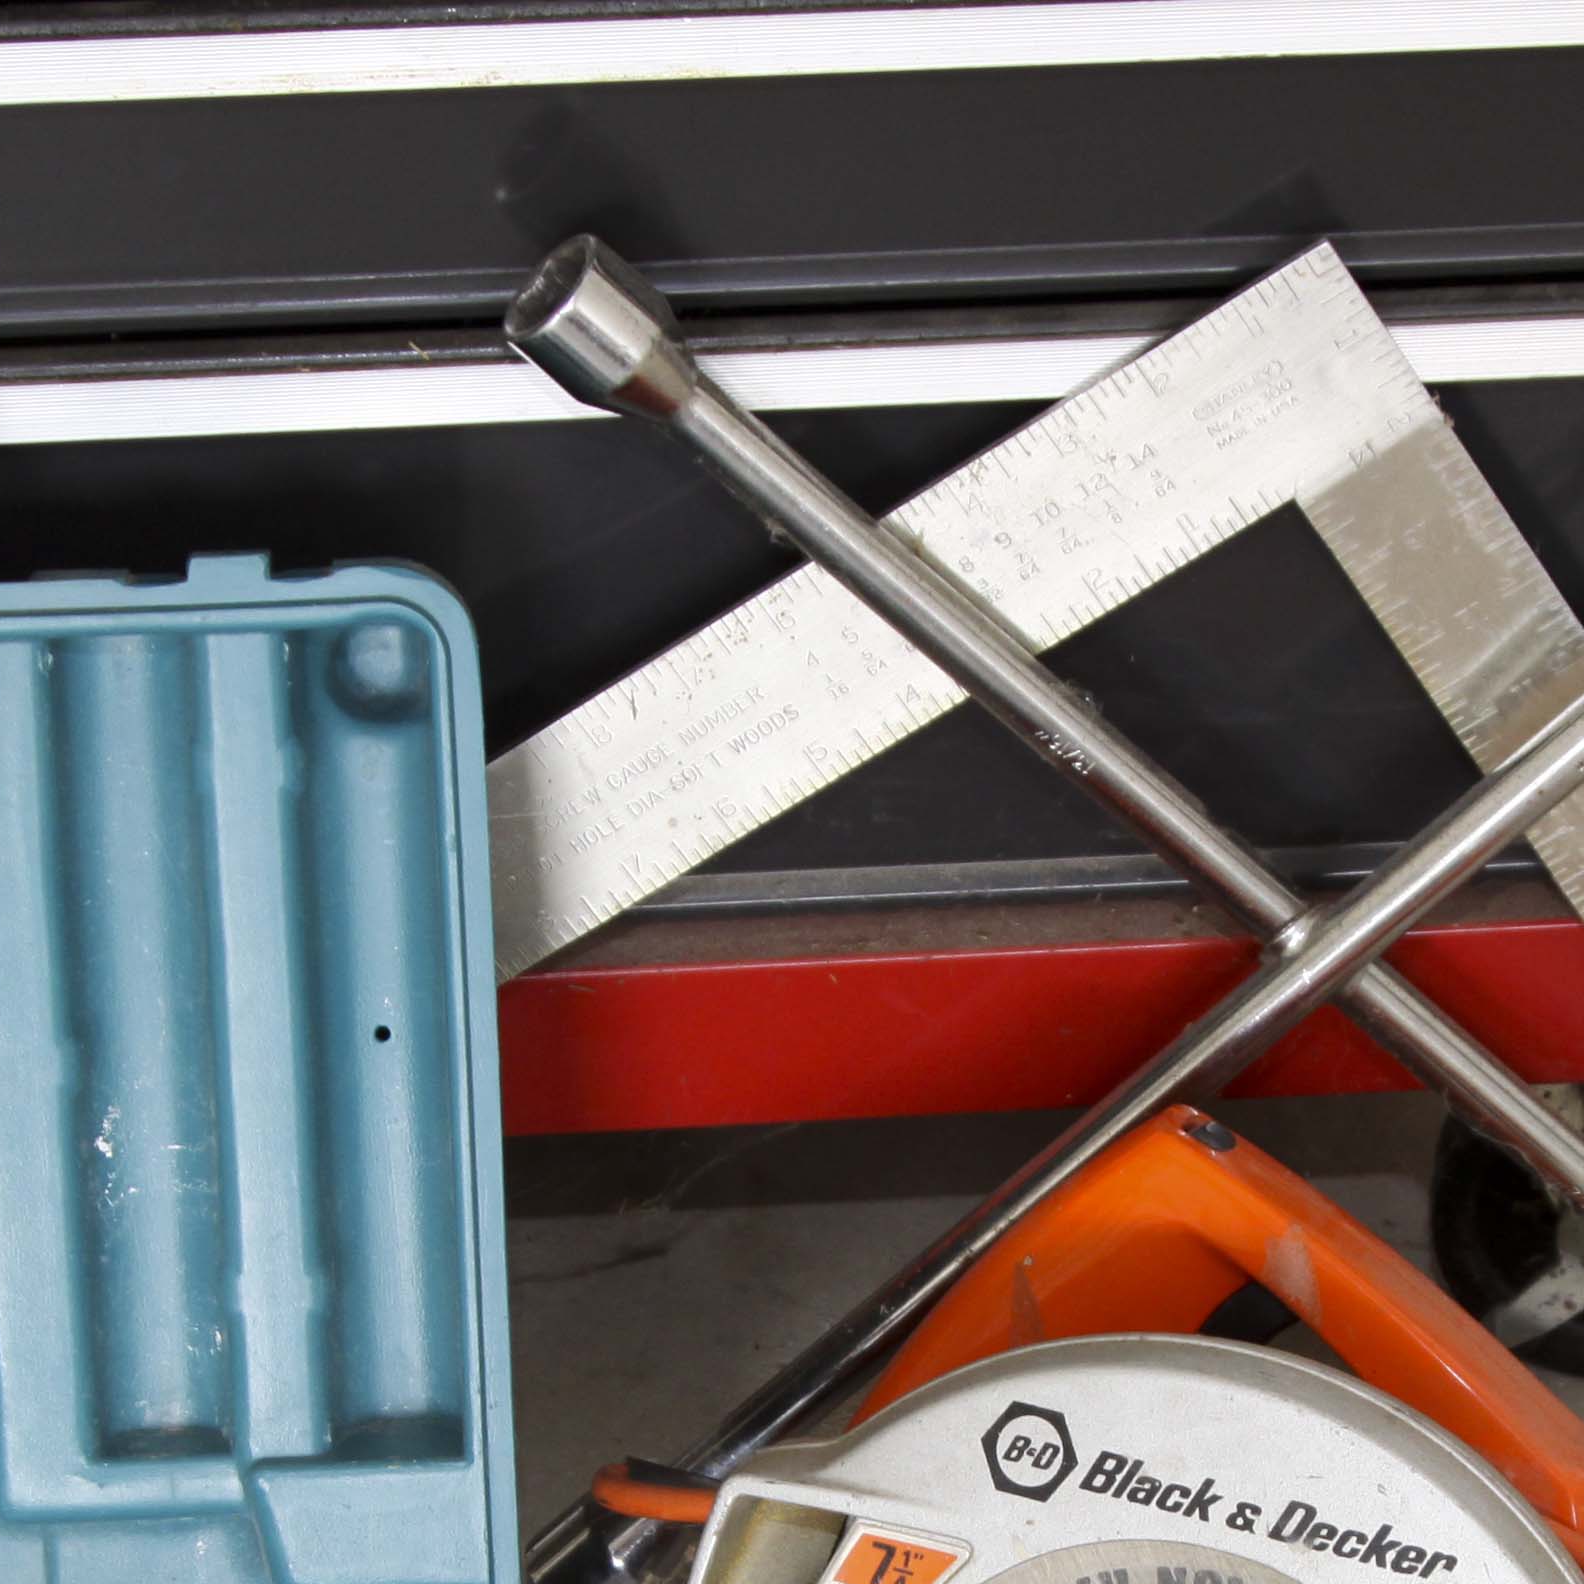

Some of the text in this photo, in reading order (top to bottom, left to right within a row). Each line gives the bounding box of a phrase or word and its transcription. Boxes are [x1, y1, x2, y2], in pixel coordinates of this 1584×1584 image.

[568, 811, 625, 855] HOLE
[725, 700, 802, 757] WOODS
[604, 739, 674, 792] GAUGE
[677, 682, 766, 747] NUMBER
[1079, 1450, 1458, 1581] Black & Decker
